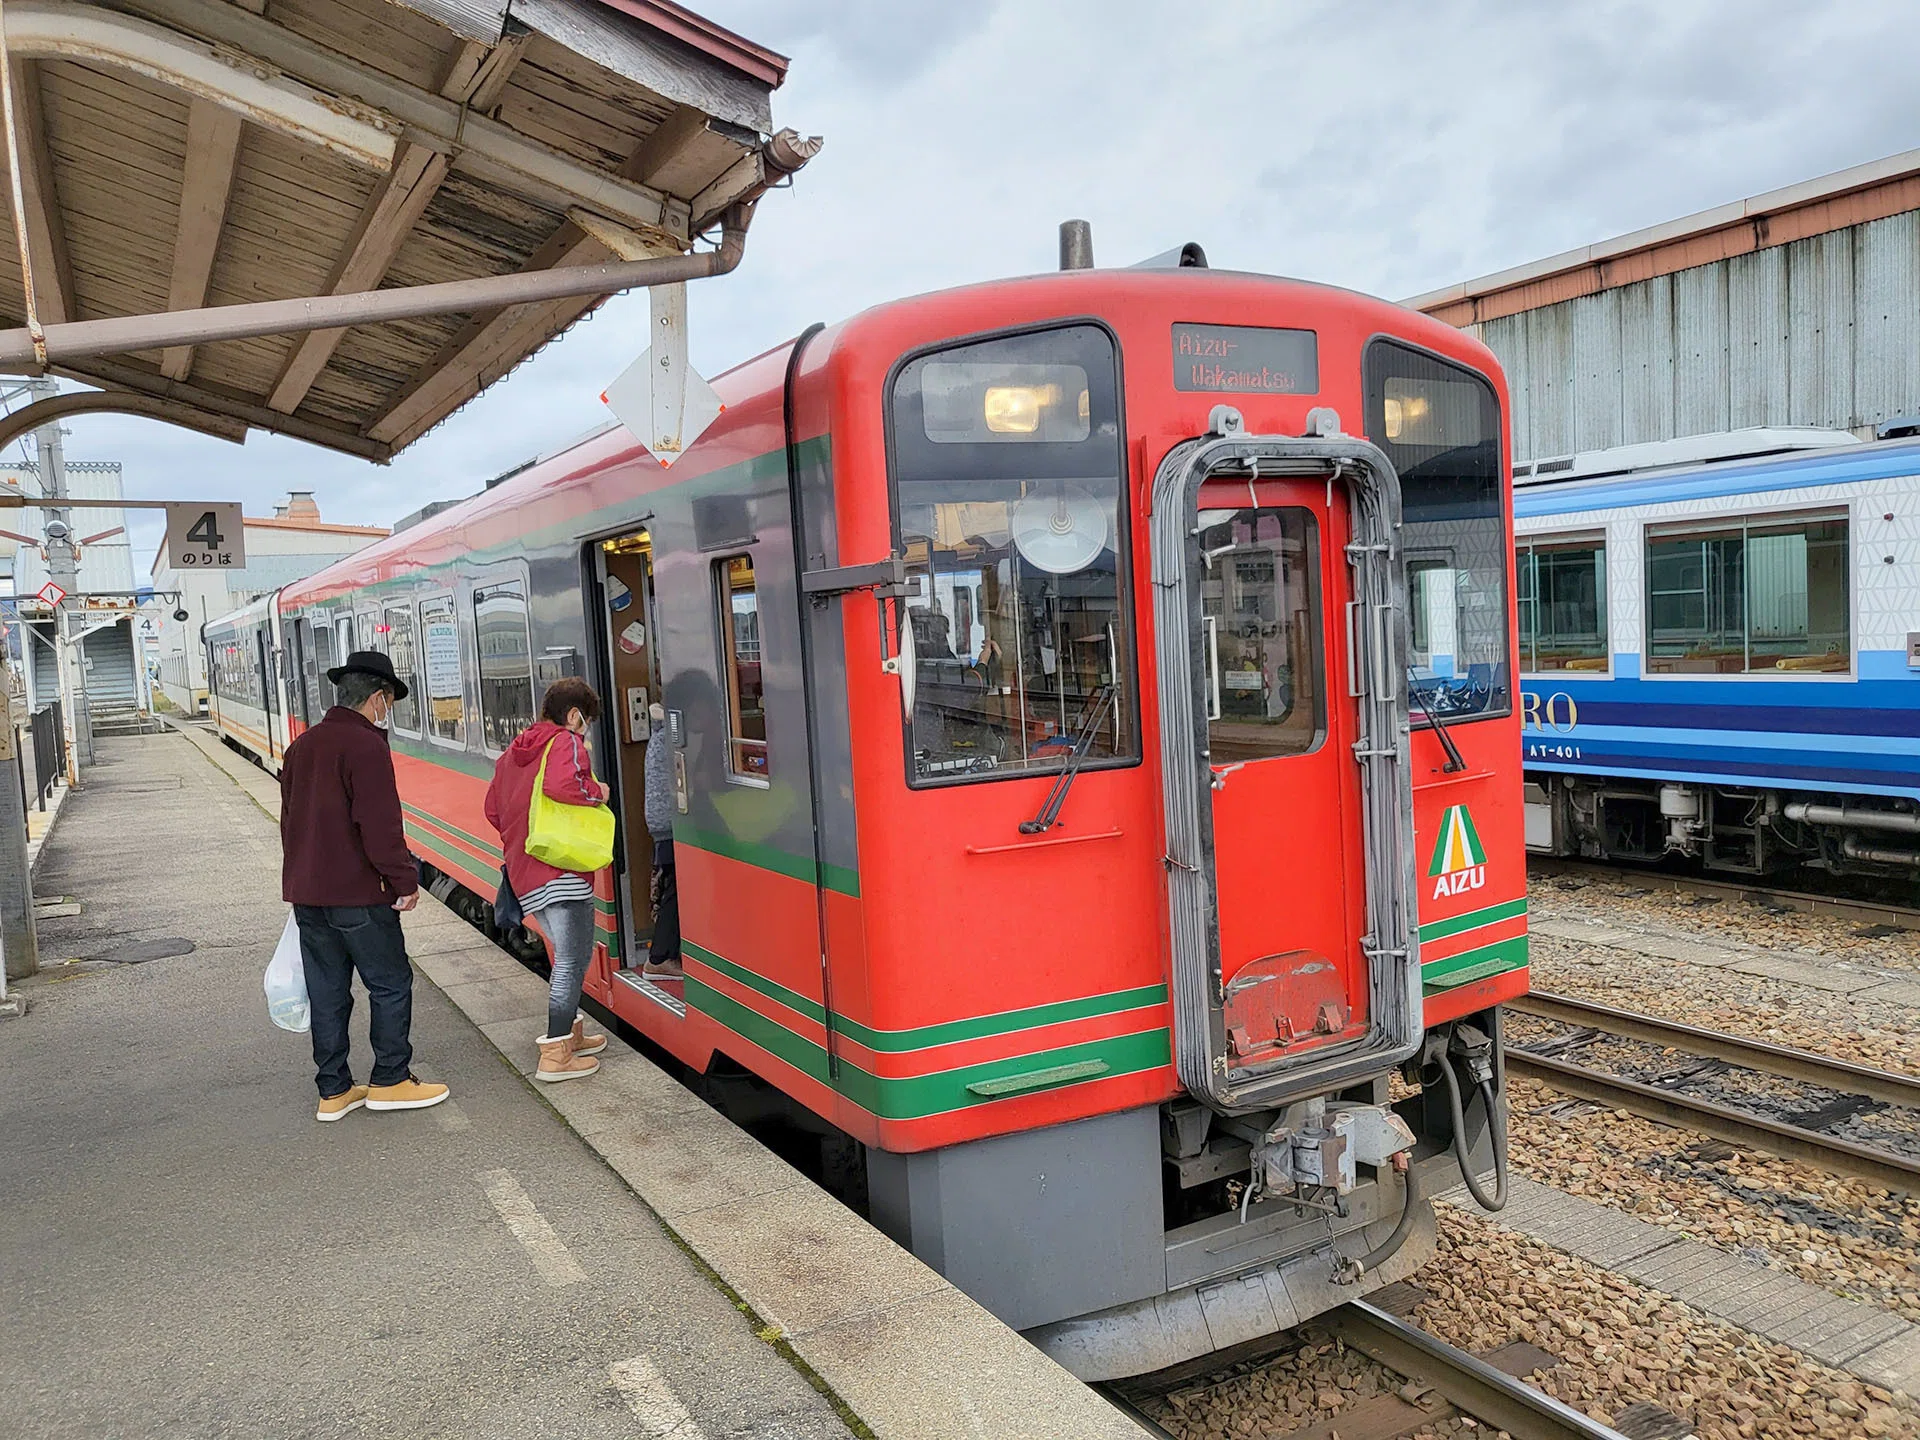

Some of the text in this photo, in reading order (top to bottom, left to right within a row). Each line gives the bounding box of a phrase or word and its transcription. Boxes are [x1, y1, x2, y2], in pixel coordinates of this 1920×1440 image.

[1192, 363, 1295, 389] Wakamatsu
[186, 511, 225, 550] 4
[182, 552, 232, 565] のりば
[141, 619, 152, 631] 4
[1530, 744, 1581, 759] AT-401
[1432, 865, 1486, 900] AIZU
